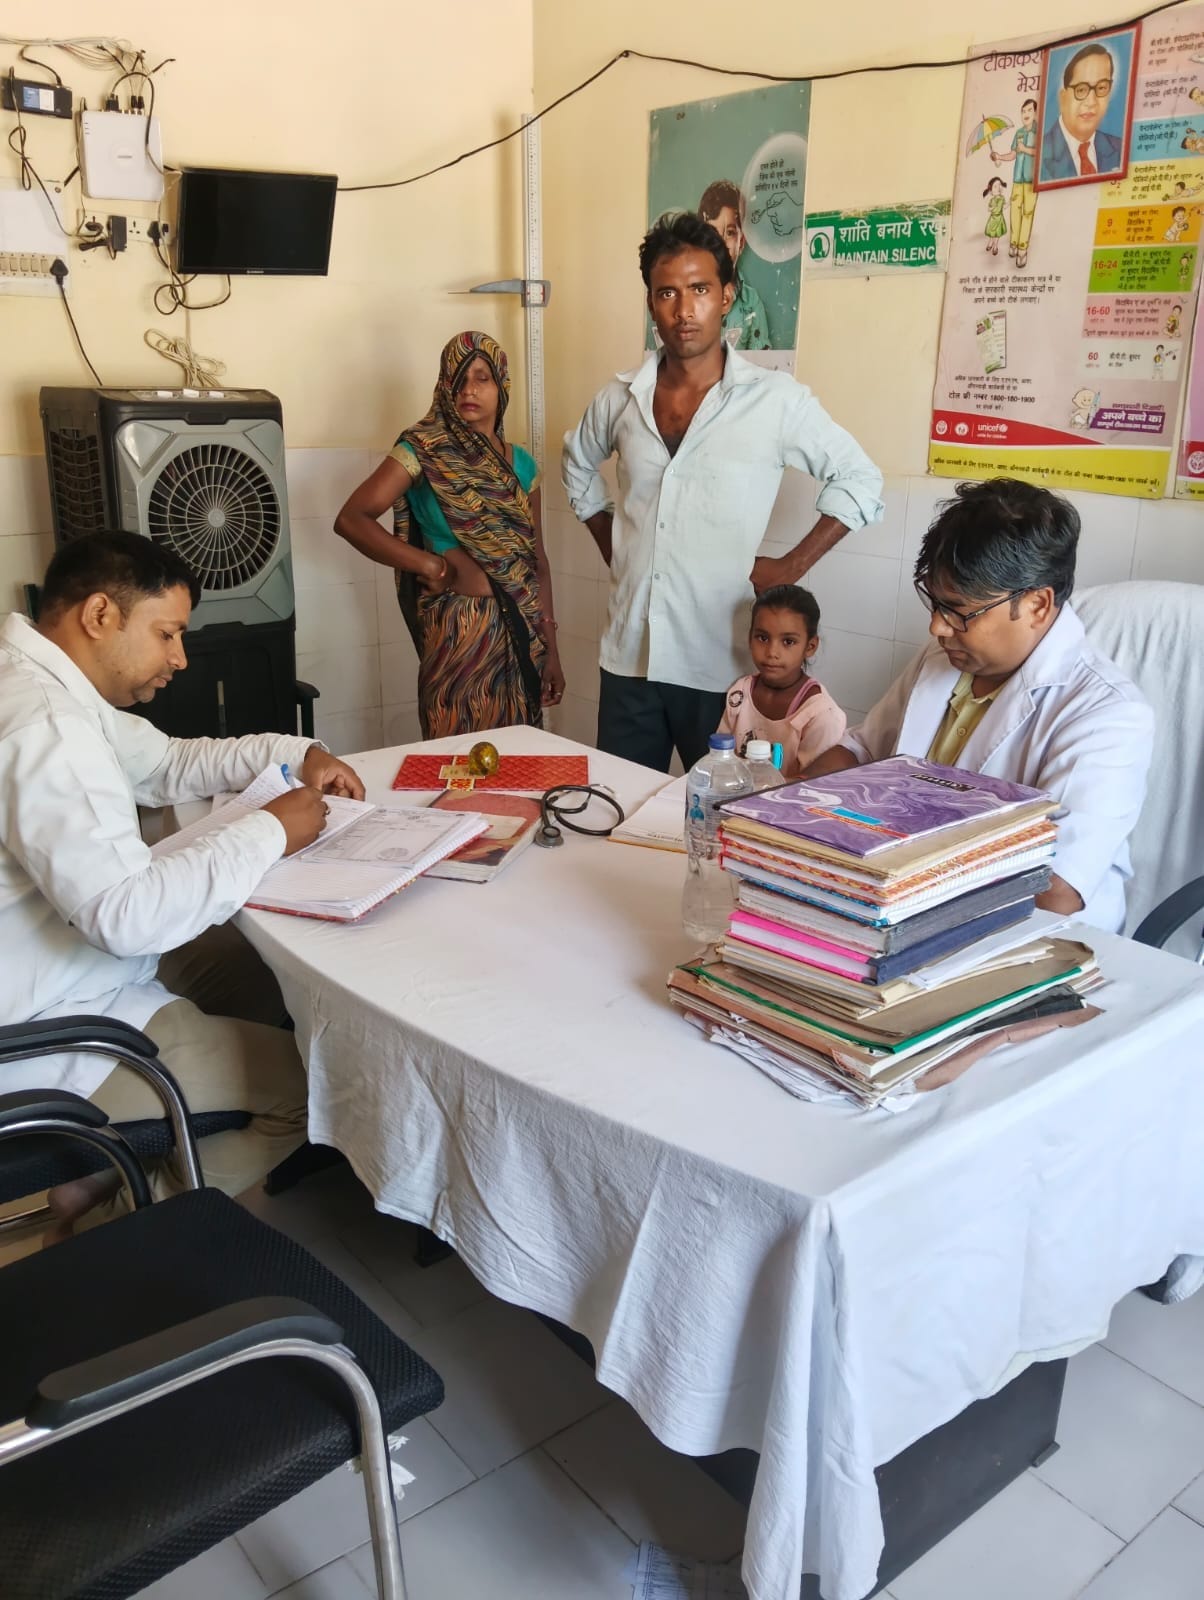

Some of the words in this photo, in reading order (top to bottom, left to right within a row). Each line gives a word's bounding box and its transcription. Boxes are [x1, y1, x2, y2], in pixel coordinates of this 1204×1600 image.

[1017, 72, 1041, 93] मेरा
[839, 219, 871, 243] शांति
[837, 249, 889, 265] MAINTAIN
[891, 246, 935, 263] SILENC
[1087, 306, 1110, 316] 16-60
[1088, 352, 1099, 361] 60
[1101, 410, 1126, 421] अपने
[1148, 414, 1163, 424] का
[977, 423, 1000, 432] unicef
